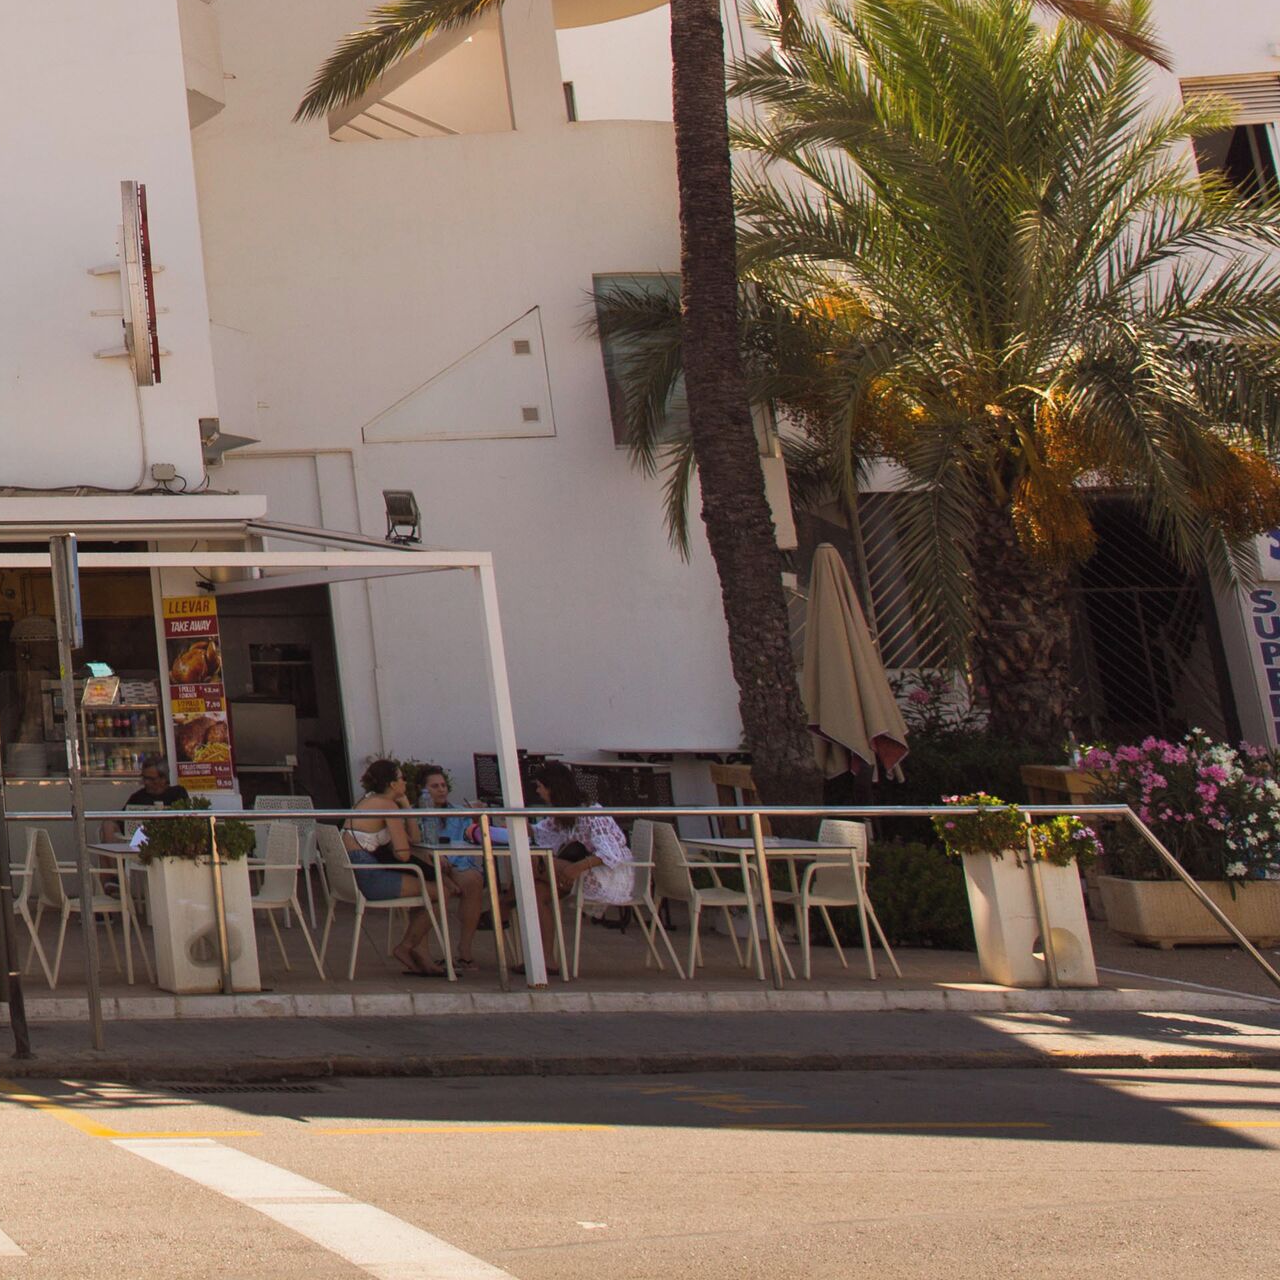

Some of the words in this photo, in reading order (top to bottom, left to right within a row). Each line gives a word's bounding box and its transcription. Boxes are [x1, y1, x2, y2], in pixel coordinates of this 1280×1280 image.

[168, 601, 210, 614] LLEVAR
[171, 621, 190, 632] TAKE
[190, 620, 212, 631] AWAY
[1249, 589, 1280, 745] SUPE
